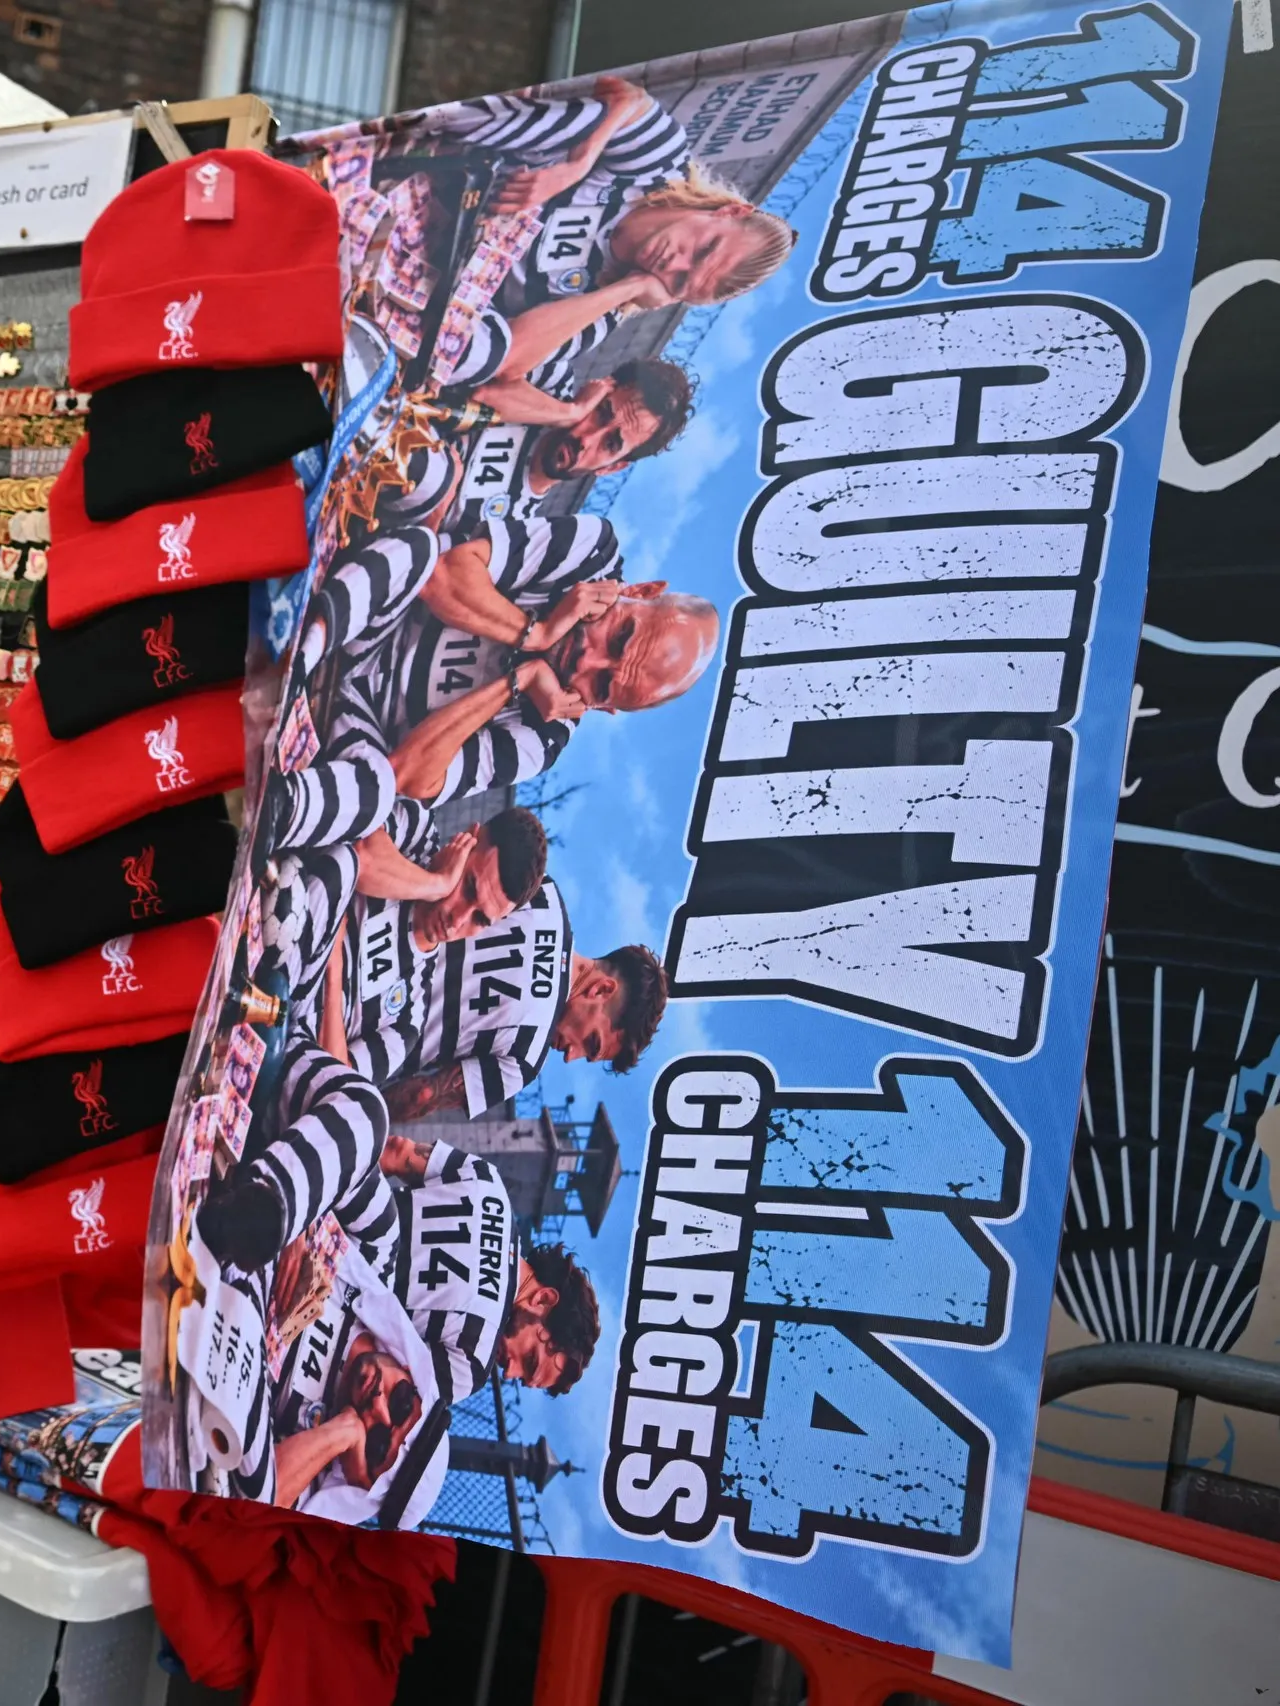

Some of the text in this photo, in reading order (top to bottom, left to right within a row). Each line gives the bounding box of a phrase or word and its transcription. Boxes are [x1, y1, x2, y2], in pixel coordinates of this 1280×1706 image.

[688, 79, 745, 154] SECURIT
[701, 72, 784, 156] MAXIMUM
[742, 72, 818, 143] ETIHAD
[928, 8, 1188, 278] 114
[25, 188, 44, 204] or
[49, 177, 89, 200] card
[820, 44, 977, 297] CHARGES
[548, 216, 591, 260] 114
[473, 438, 514, 486] 114
[436, 636, 481, 694] 114
[674, 304, 1127, 1040] GUILTY
[367, 921, 393, 982] 114
[469, 926, 526, 1016] 114
[530, 929, 557, 999] ENZO
[418, 1195, 474, 1291] 114
[477, 1195, 505, 1302] CHERKI
[614, 1070, 763, 1525] CHARGES
[720, 1072, 1008, 1538] 114
[301, 1318, 334, 1383] 114
